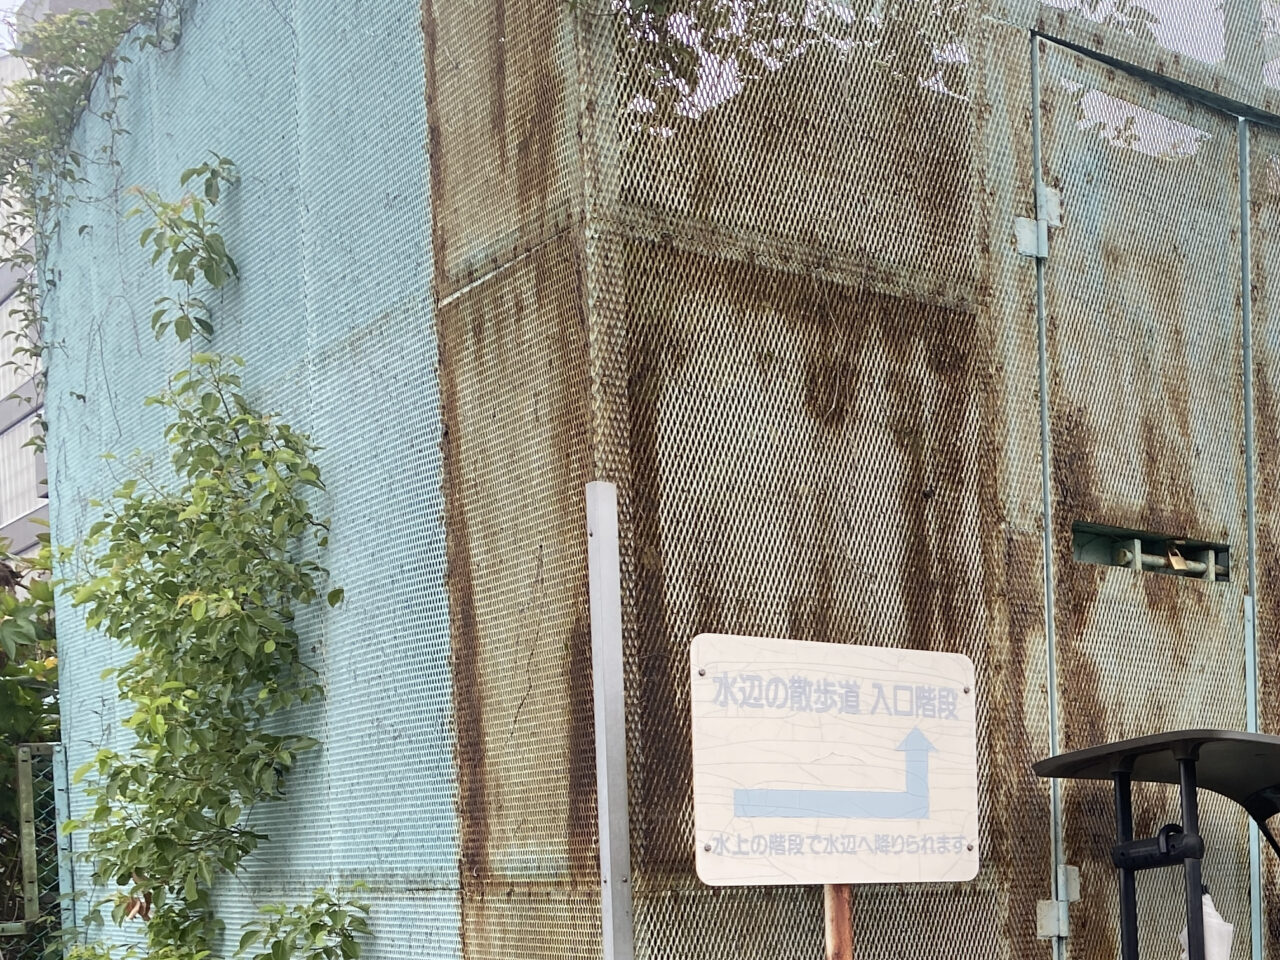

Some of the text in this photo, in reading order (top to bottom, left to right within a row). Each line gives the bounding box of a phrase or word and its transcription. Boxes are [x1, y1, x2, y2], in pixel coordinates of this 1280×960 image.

[711, 672, 960, 720] 水辺の散歩道 入口階段
